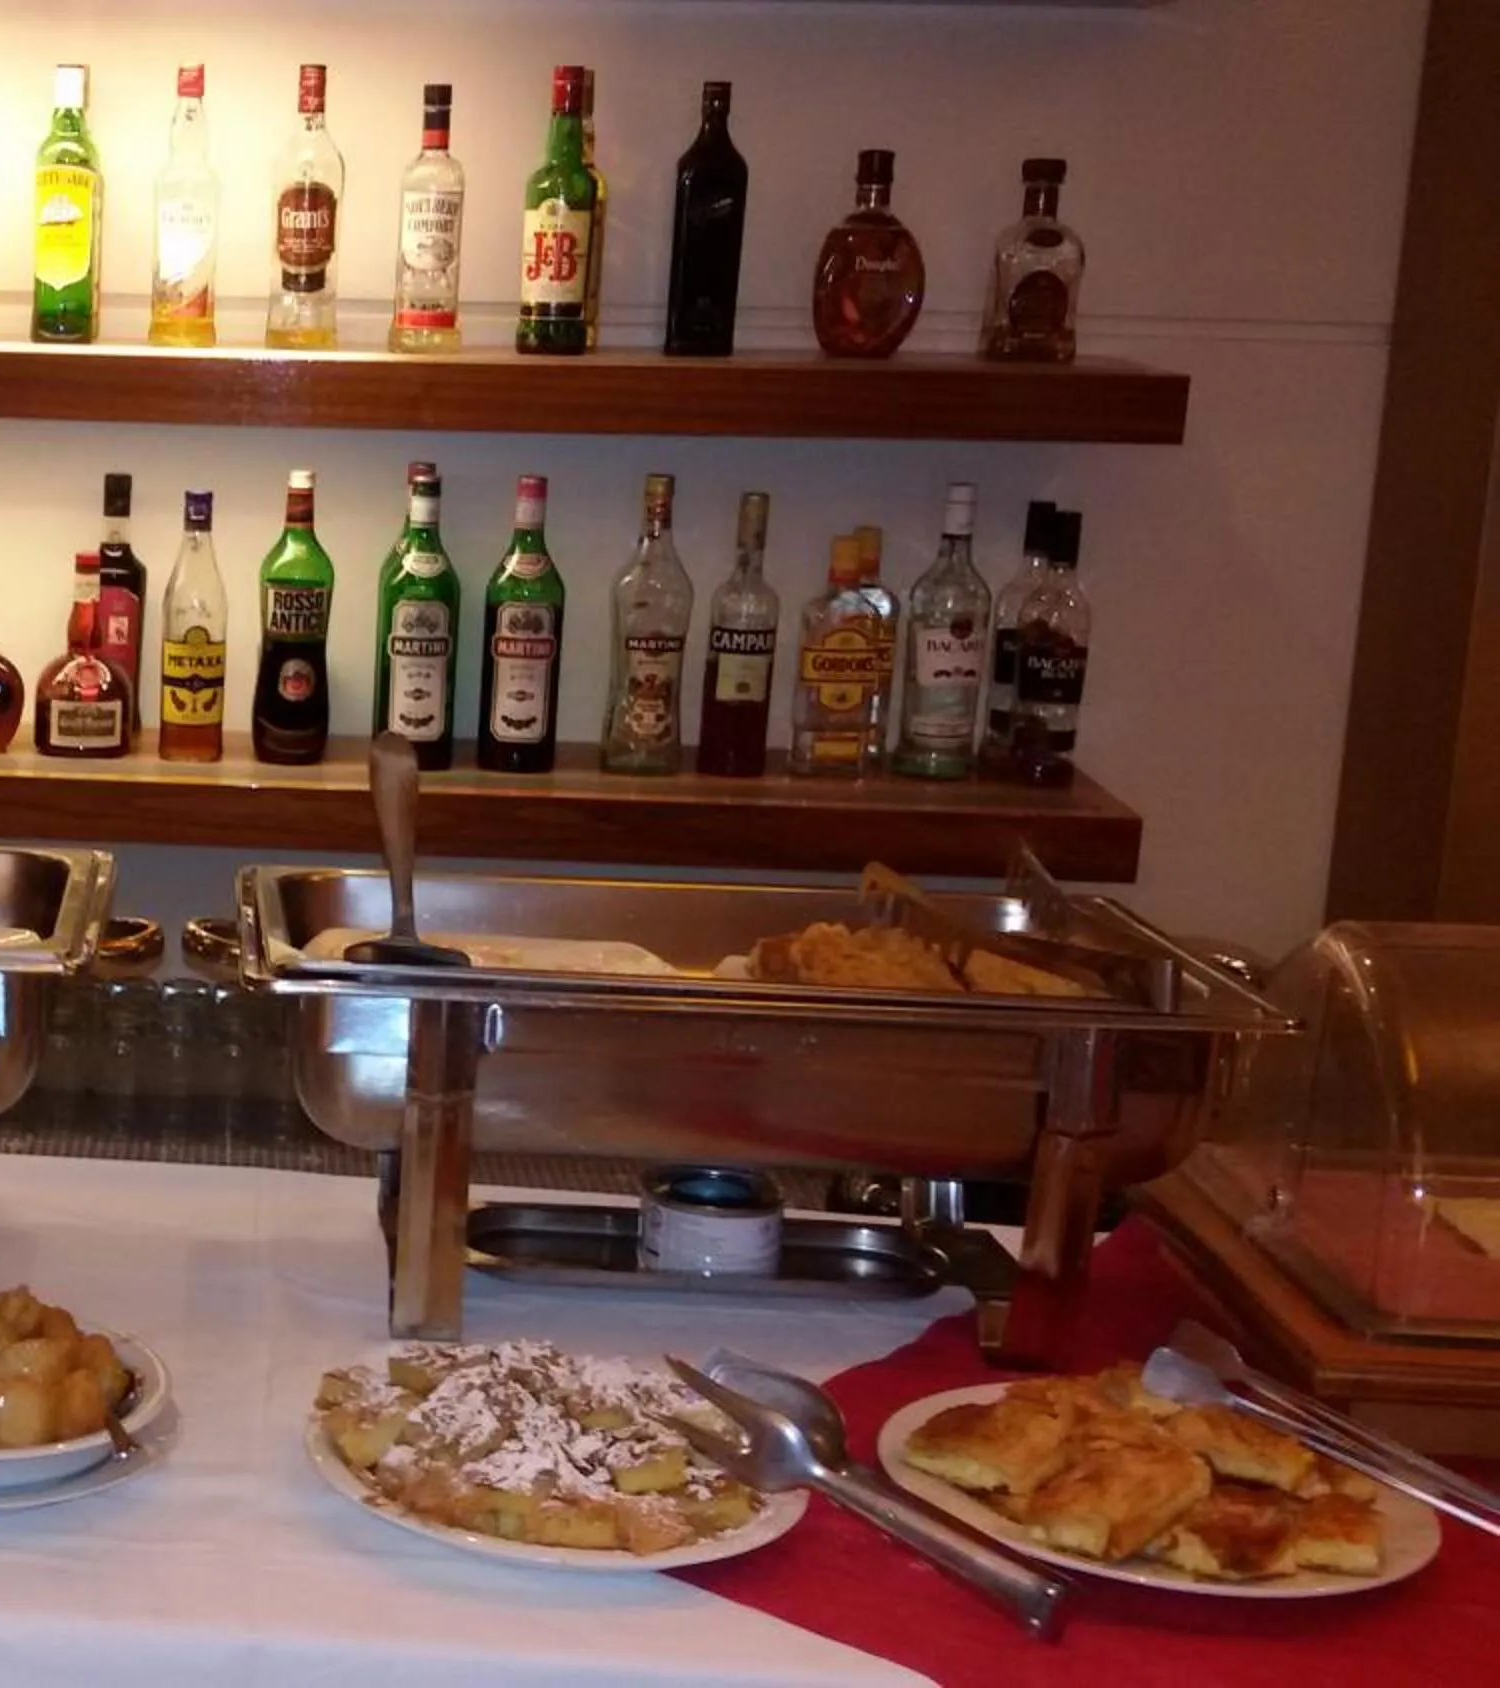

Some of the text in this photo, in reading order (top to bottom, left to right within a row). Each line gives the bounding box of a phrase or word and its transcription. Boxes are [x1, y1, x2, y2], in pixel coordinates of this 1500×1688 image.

[273, 591, 325, 611] ROSSO
[393, 637, 447, 656] MARTINI
[496, 639, 554, 658] MARTINI
[628, 638, 682, 650] MARTINI
[167, 654, 223, 669] METAXA
